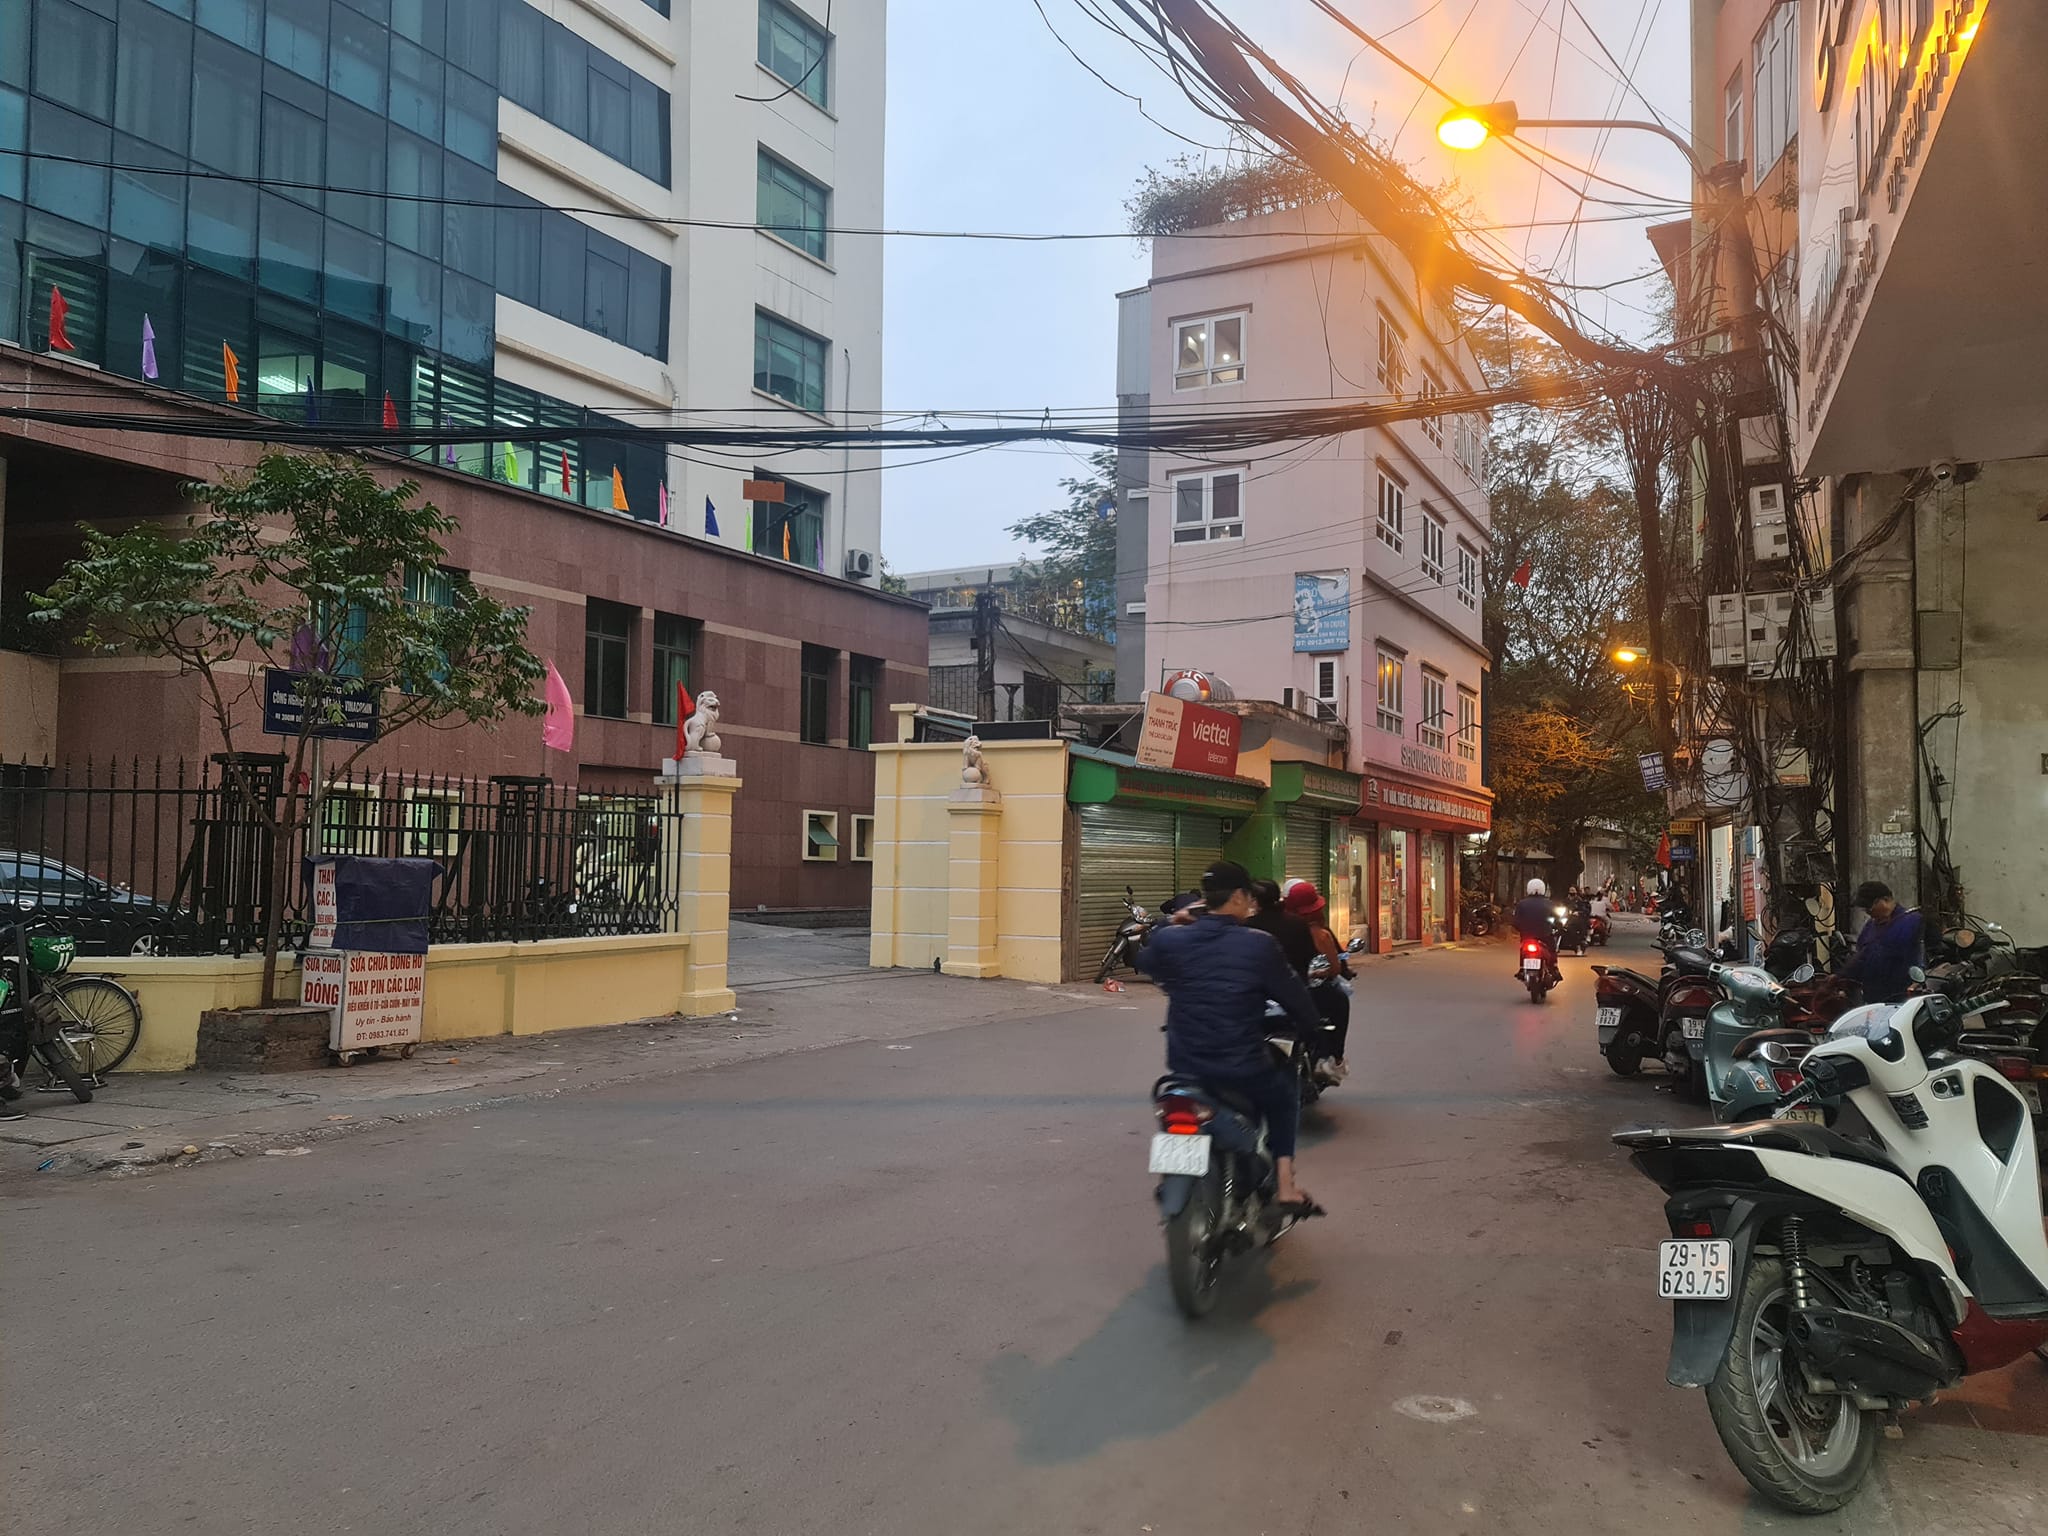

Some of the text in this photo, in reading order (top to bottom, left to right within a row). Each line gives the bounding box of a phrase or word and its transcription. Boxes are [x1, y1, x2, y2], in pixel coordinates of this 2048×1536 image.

[1148, 716, 1166, 728] THANH
[1192, 719, 1230, 747] viettel
[1401, 744, 1441, 776] SHOWROOM
[317, 886, 331, 906] CÁC
[304, 976, 340, 1006] ĐỒNG
[348, 974, 422, 996] THAY PIN CÁC LOẠI
[355, 1018, 365, 1028] Uy
[1669, 1243, 1720, 1267] 29-Y5
[1662, 1270, 1726, 1295] 629.75
